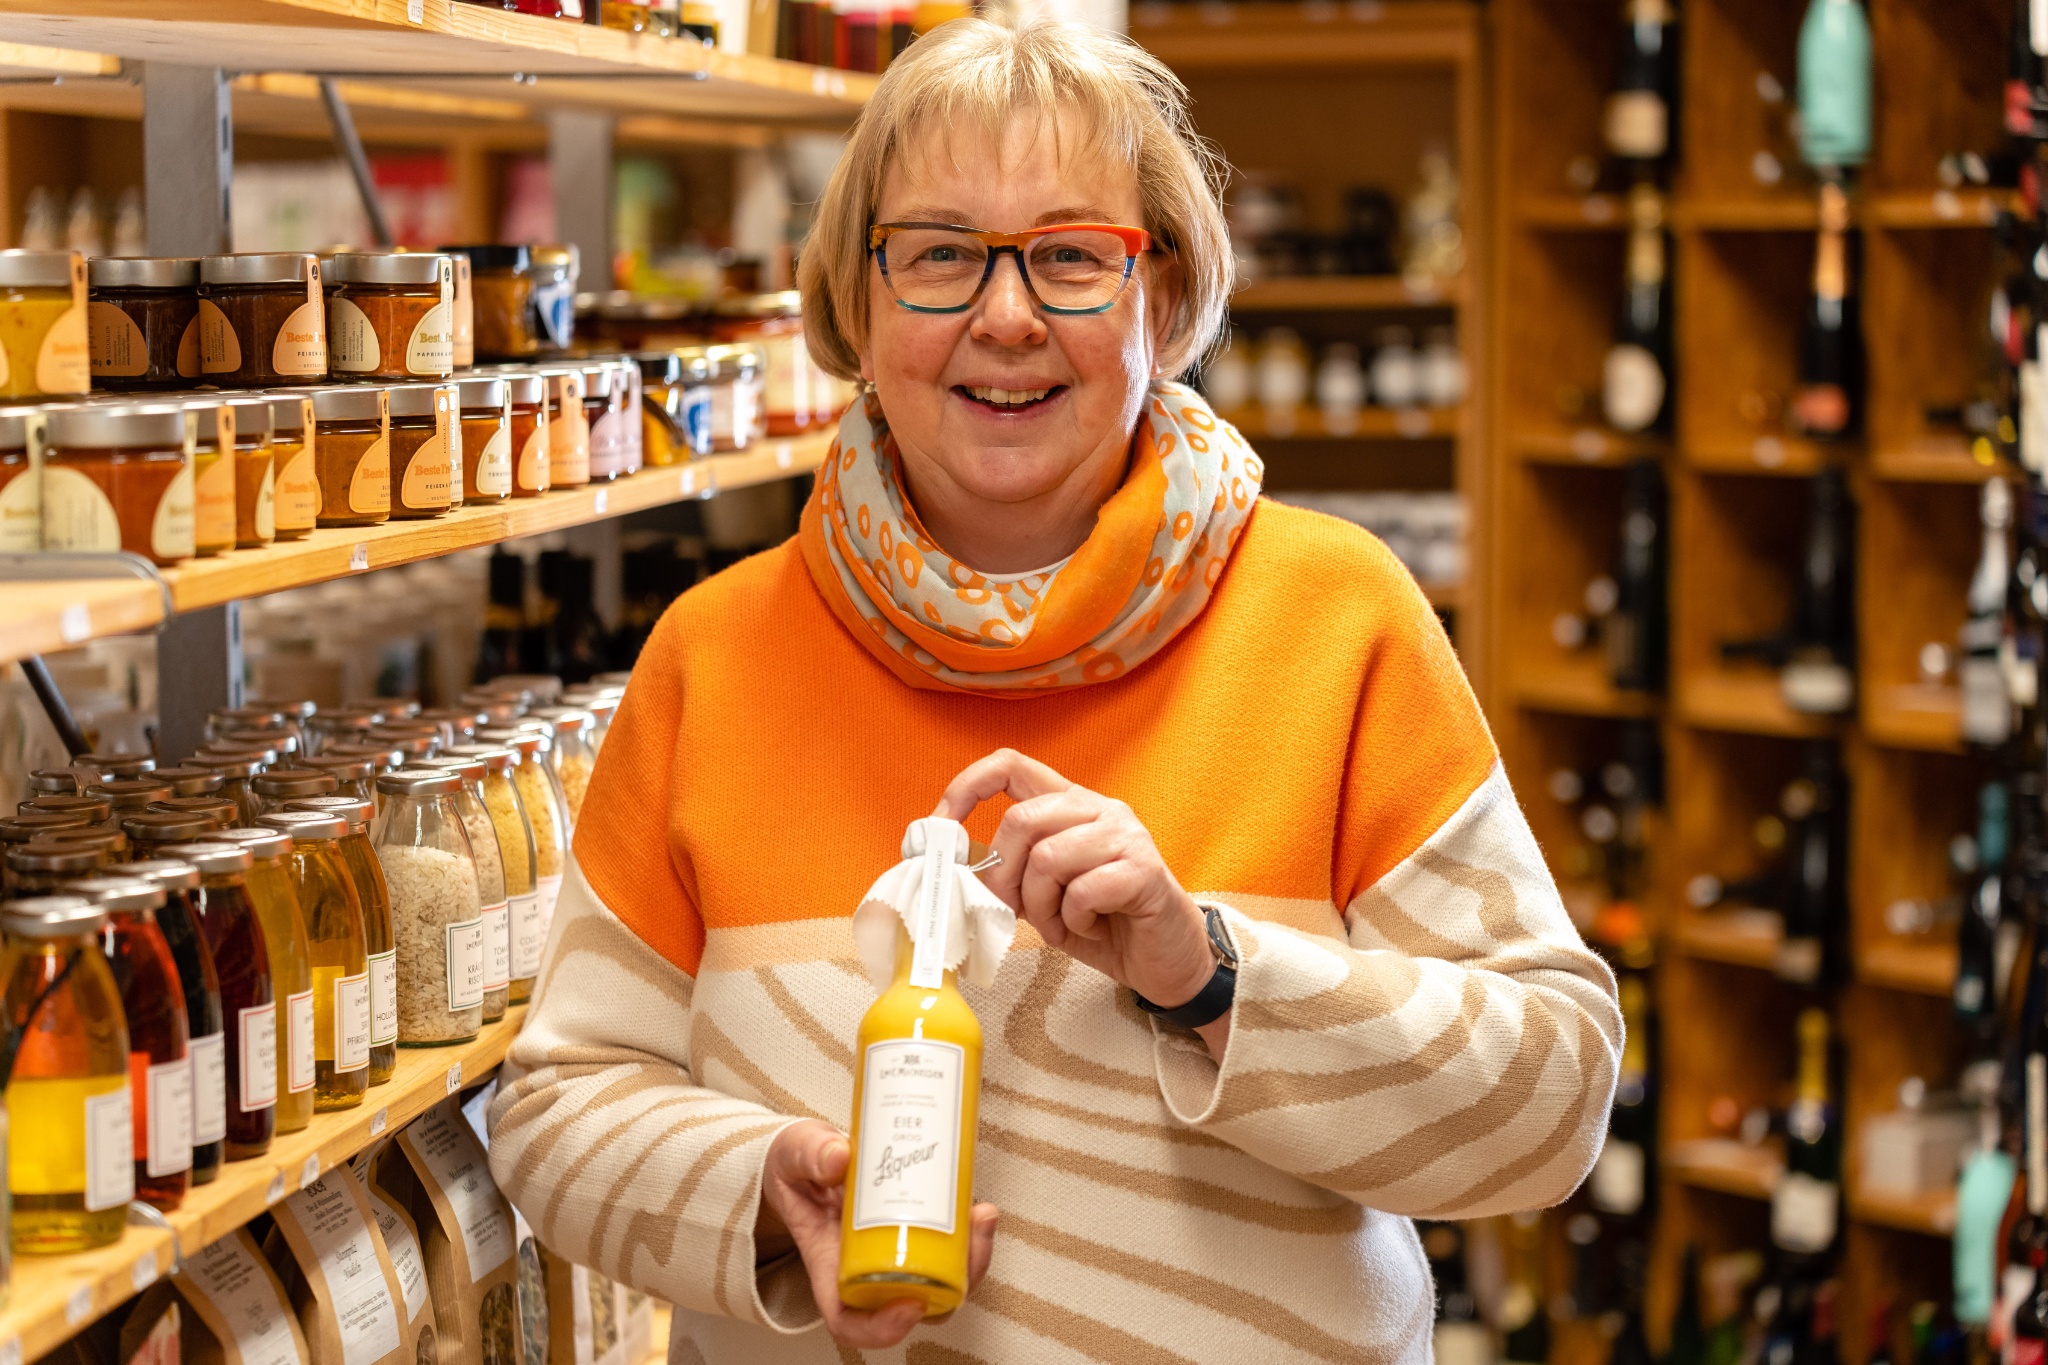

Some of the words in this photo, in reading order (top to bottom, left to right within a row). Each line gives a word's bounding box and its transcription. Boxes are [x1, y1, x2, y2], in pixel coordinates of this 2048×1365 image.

[285, 331, 314, 344] Beste
[414, 465, 441, 478] Beste
[893, 1115, 924, 1129] EIER
[872, 1141, 940, 1188] Liqueur
